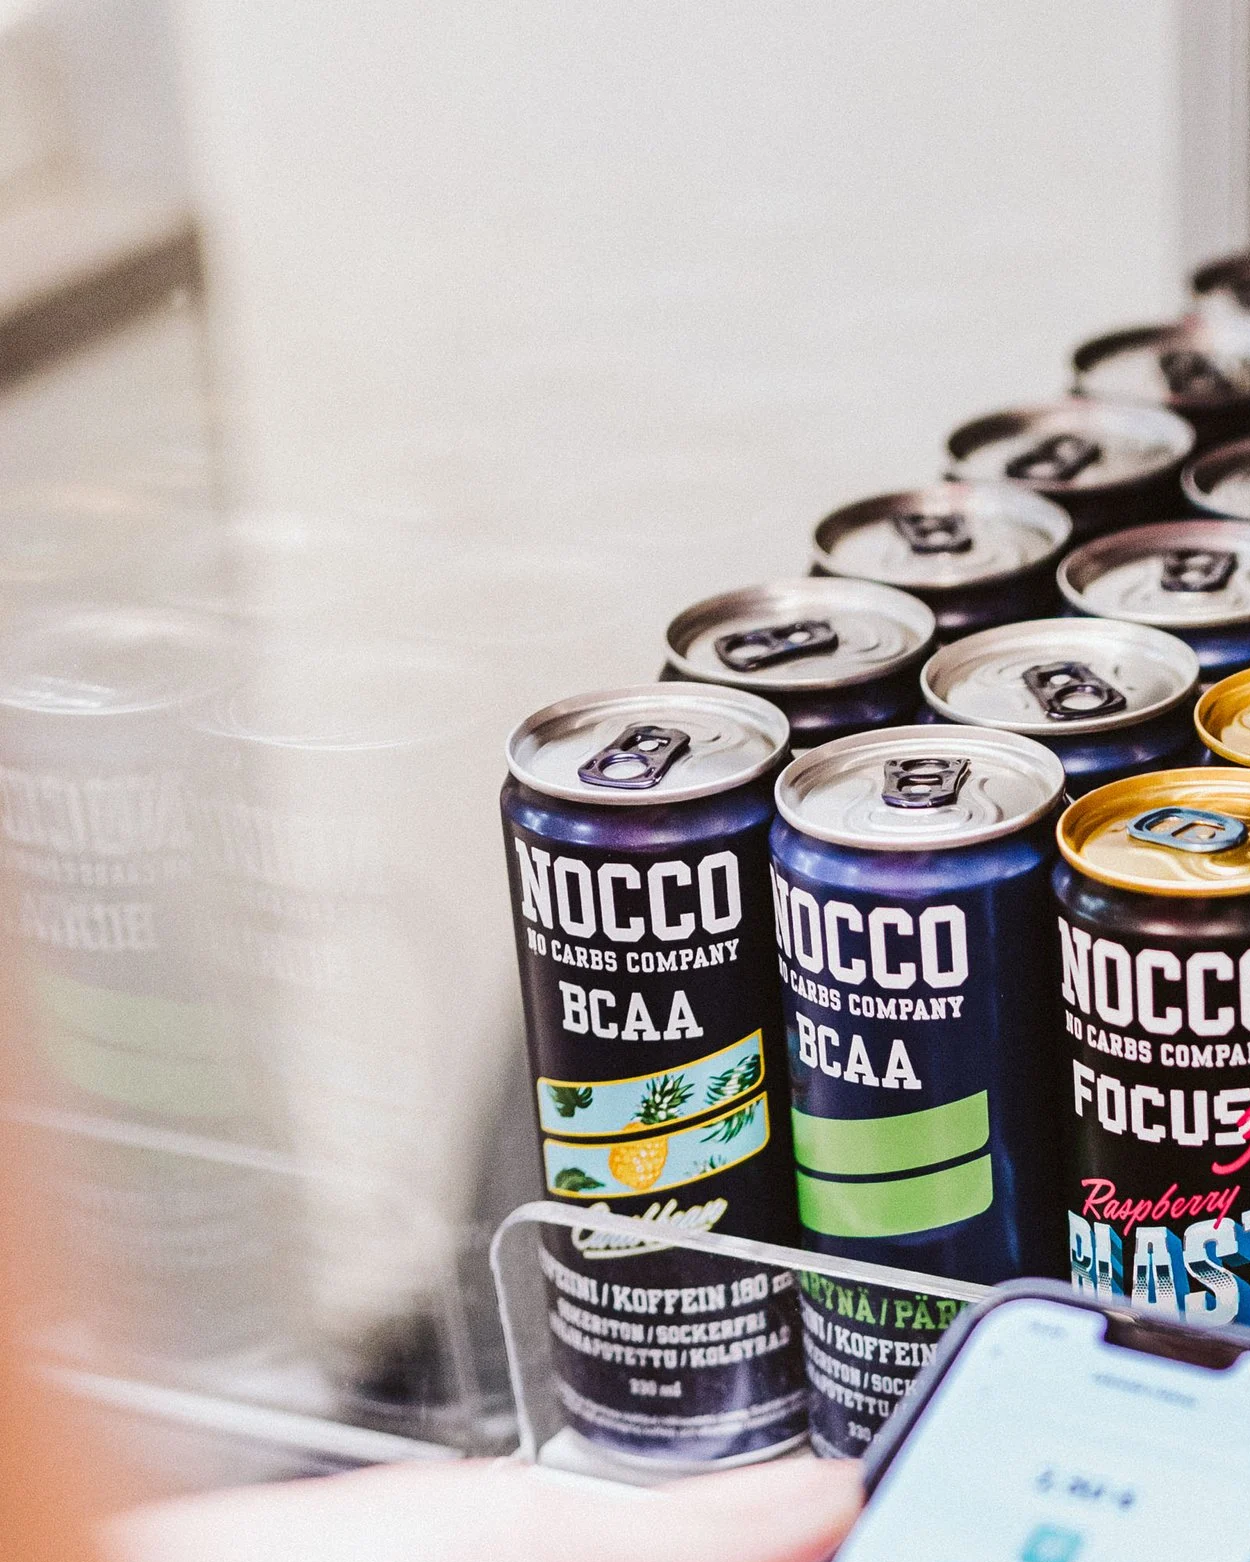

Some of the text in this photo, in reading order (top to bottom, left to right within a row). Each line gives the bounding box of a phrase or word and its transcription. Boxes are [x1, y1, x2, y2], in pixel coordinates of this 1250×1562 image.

[515, 836, 742, 942] NOCCO
[527, 927, 739, 973] NO CARBS COMPANY
[769, 863, 968, 990] NOCCO
[558, 980, 704, 1041] BCAA
[790, 969, 842, 1012] CARBS
[848, 995, 964, 1020] COMPANY
[795, 1011, 922, 1089] BCAA
[1065, 1010, 1083, 1041] NO
[1086, 1024, 1152, 1064] CARBS
[1081, 1178, 1240, 1235] Raspberry
[611, 1283, 726, 1315] KOFFEIN
[731, 1272, 769, 1307] 180
[800, 1270, 857, 1326] RYNÄ
[894, 1294, 968, 1330] PÄR
[834, 1325, 938, 1367] KOFFEIN
[870, 1373, 916, 1397] SOCK
